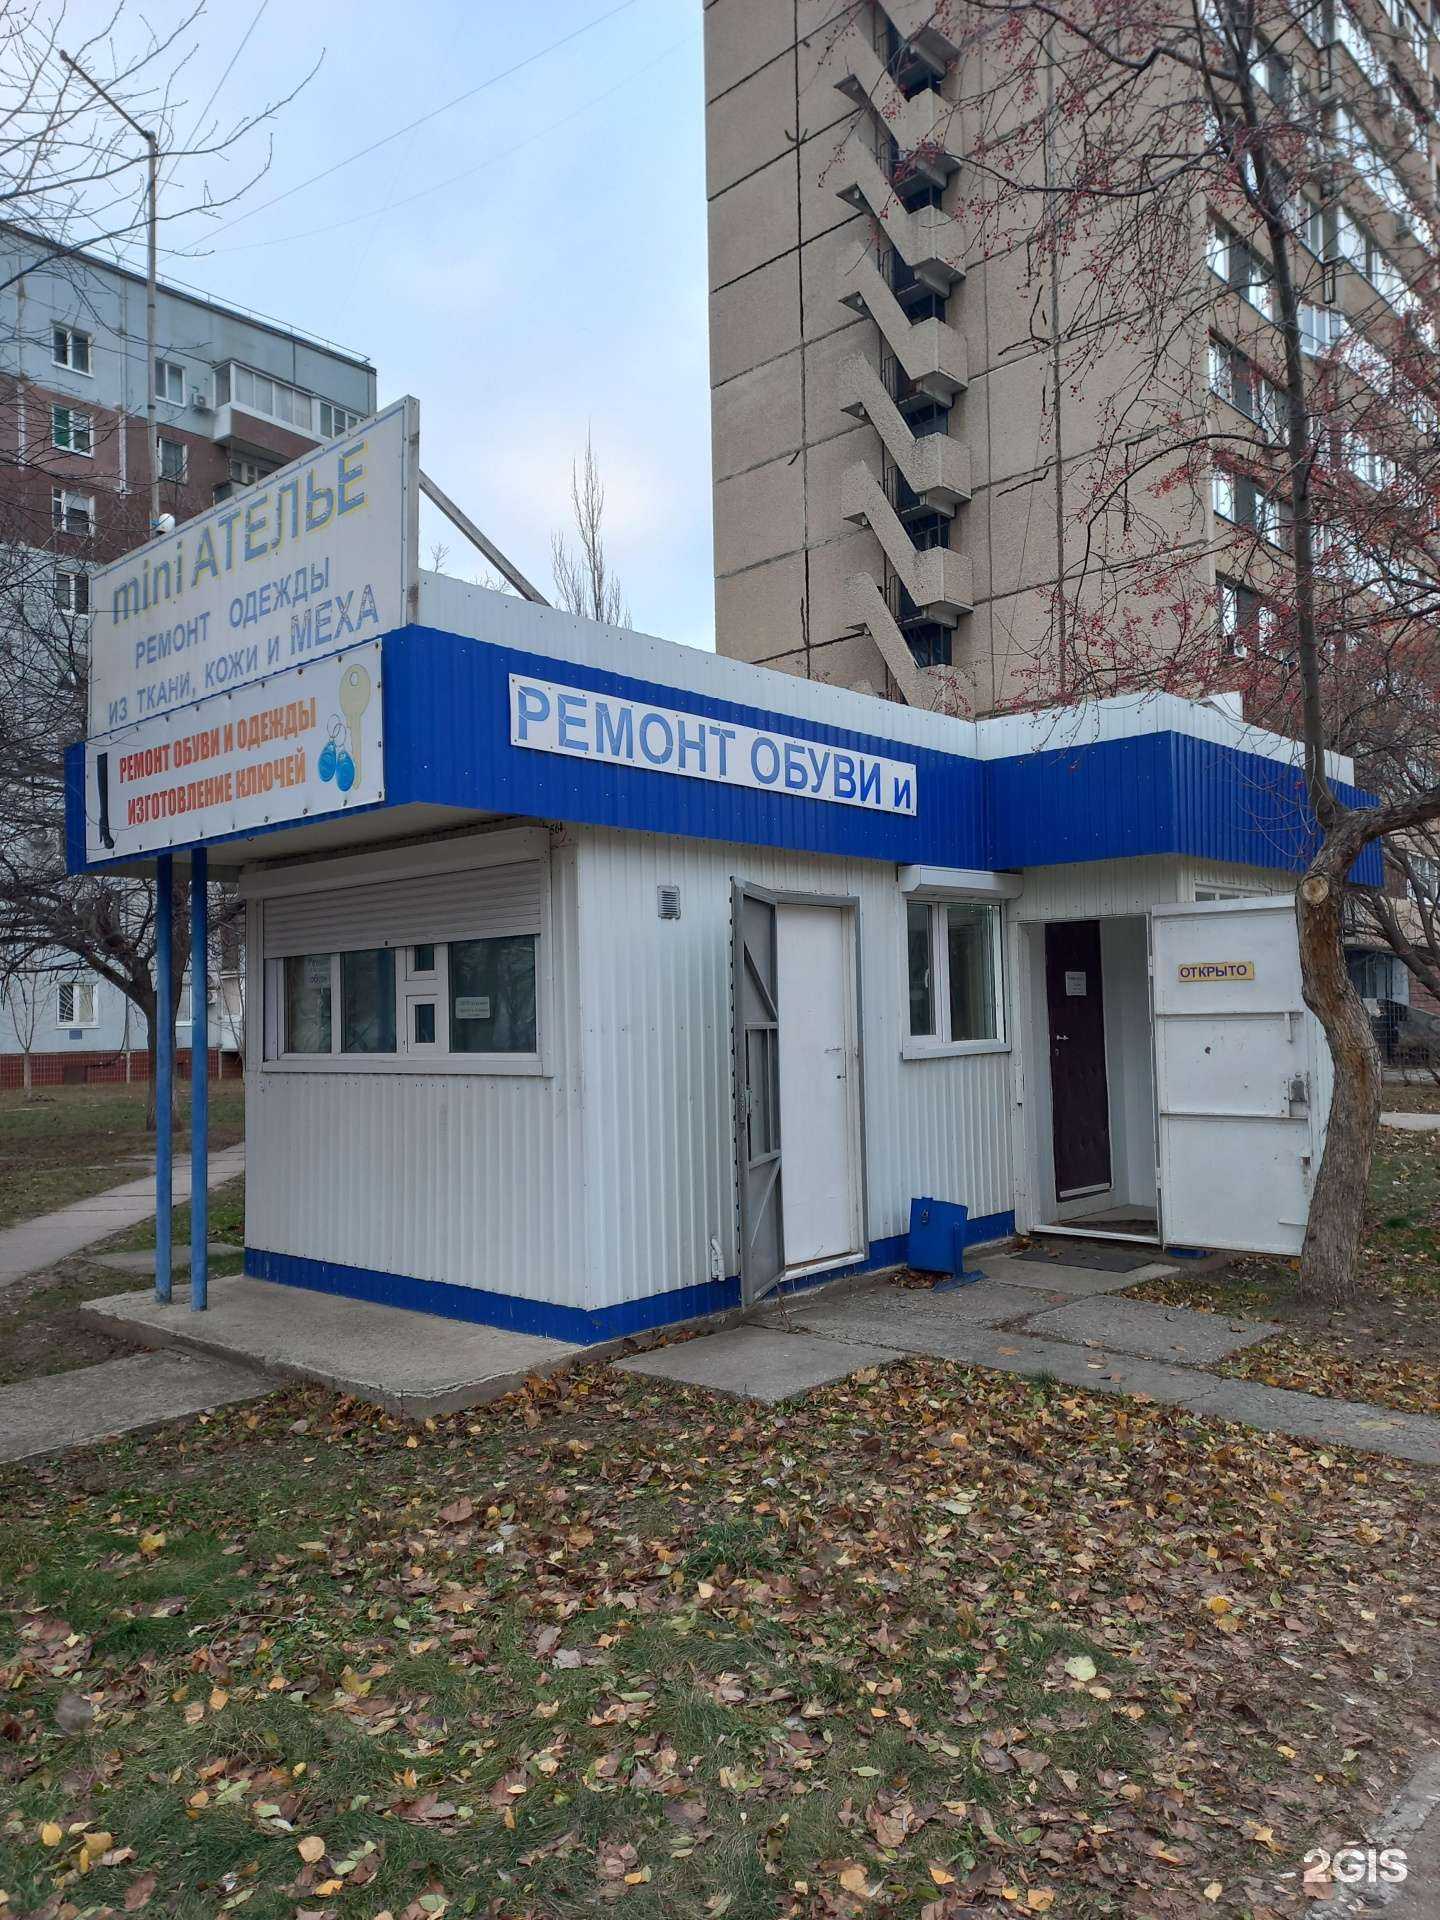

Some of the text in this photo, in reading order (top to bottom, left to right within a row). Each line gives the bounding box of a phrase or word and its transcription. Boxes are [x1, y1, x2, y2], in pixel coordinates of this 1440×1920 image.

[108, 583, 379, 724] ИЗ ТКАНИ, КОЖИ И МЕХА
[135, 557, 331, 669] РЕМОНТ ОДЕЖДЫ
[119, 697, 316, 783] РЕМОНТ ОБУВИ И ОДЕЖДЫ
[127, 747, 305, 825] ИЗГОТОВЛЕНИЕ КЛЮЧЕЙ
[517, 686, 736, 776] РЕМОНТ
[750, 736, 881, 805] ОБУВИ
[1180, 964, 1247, 978] ОТКРЫТО
